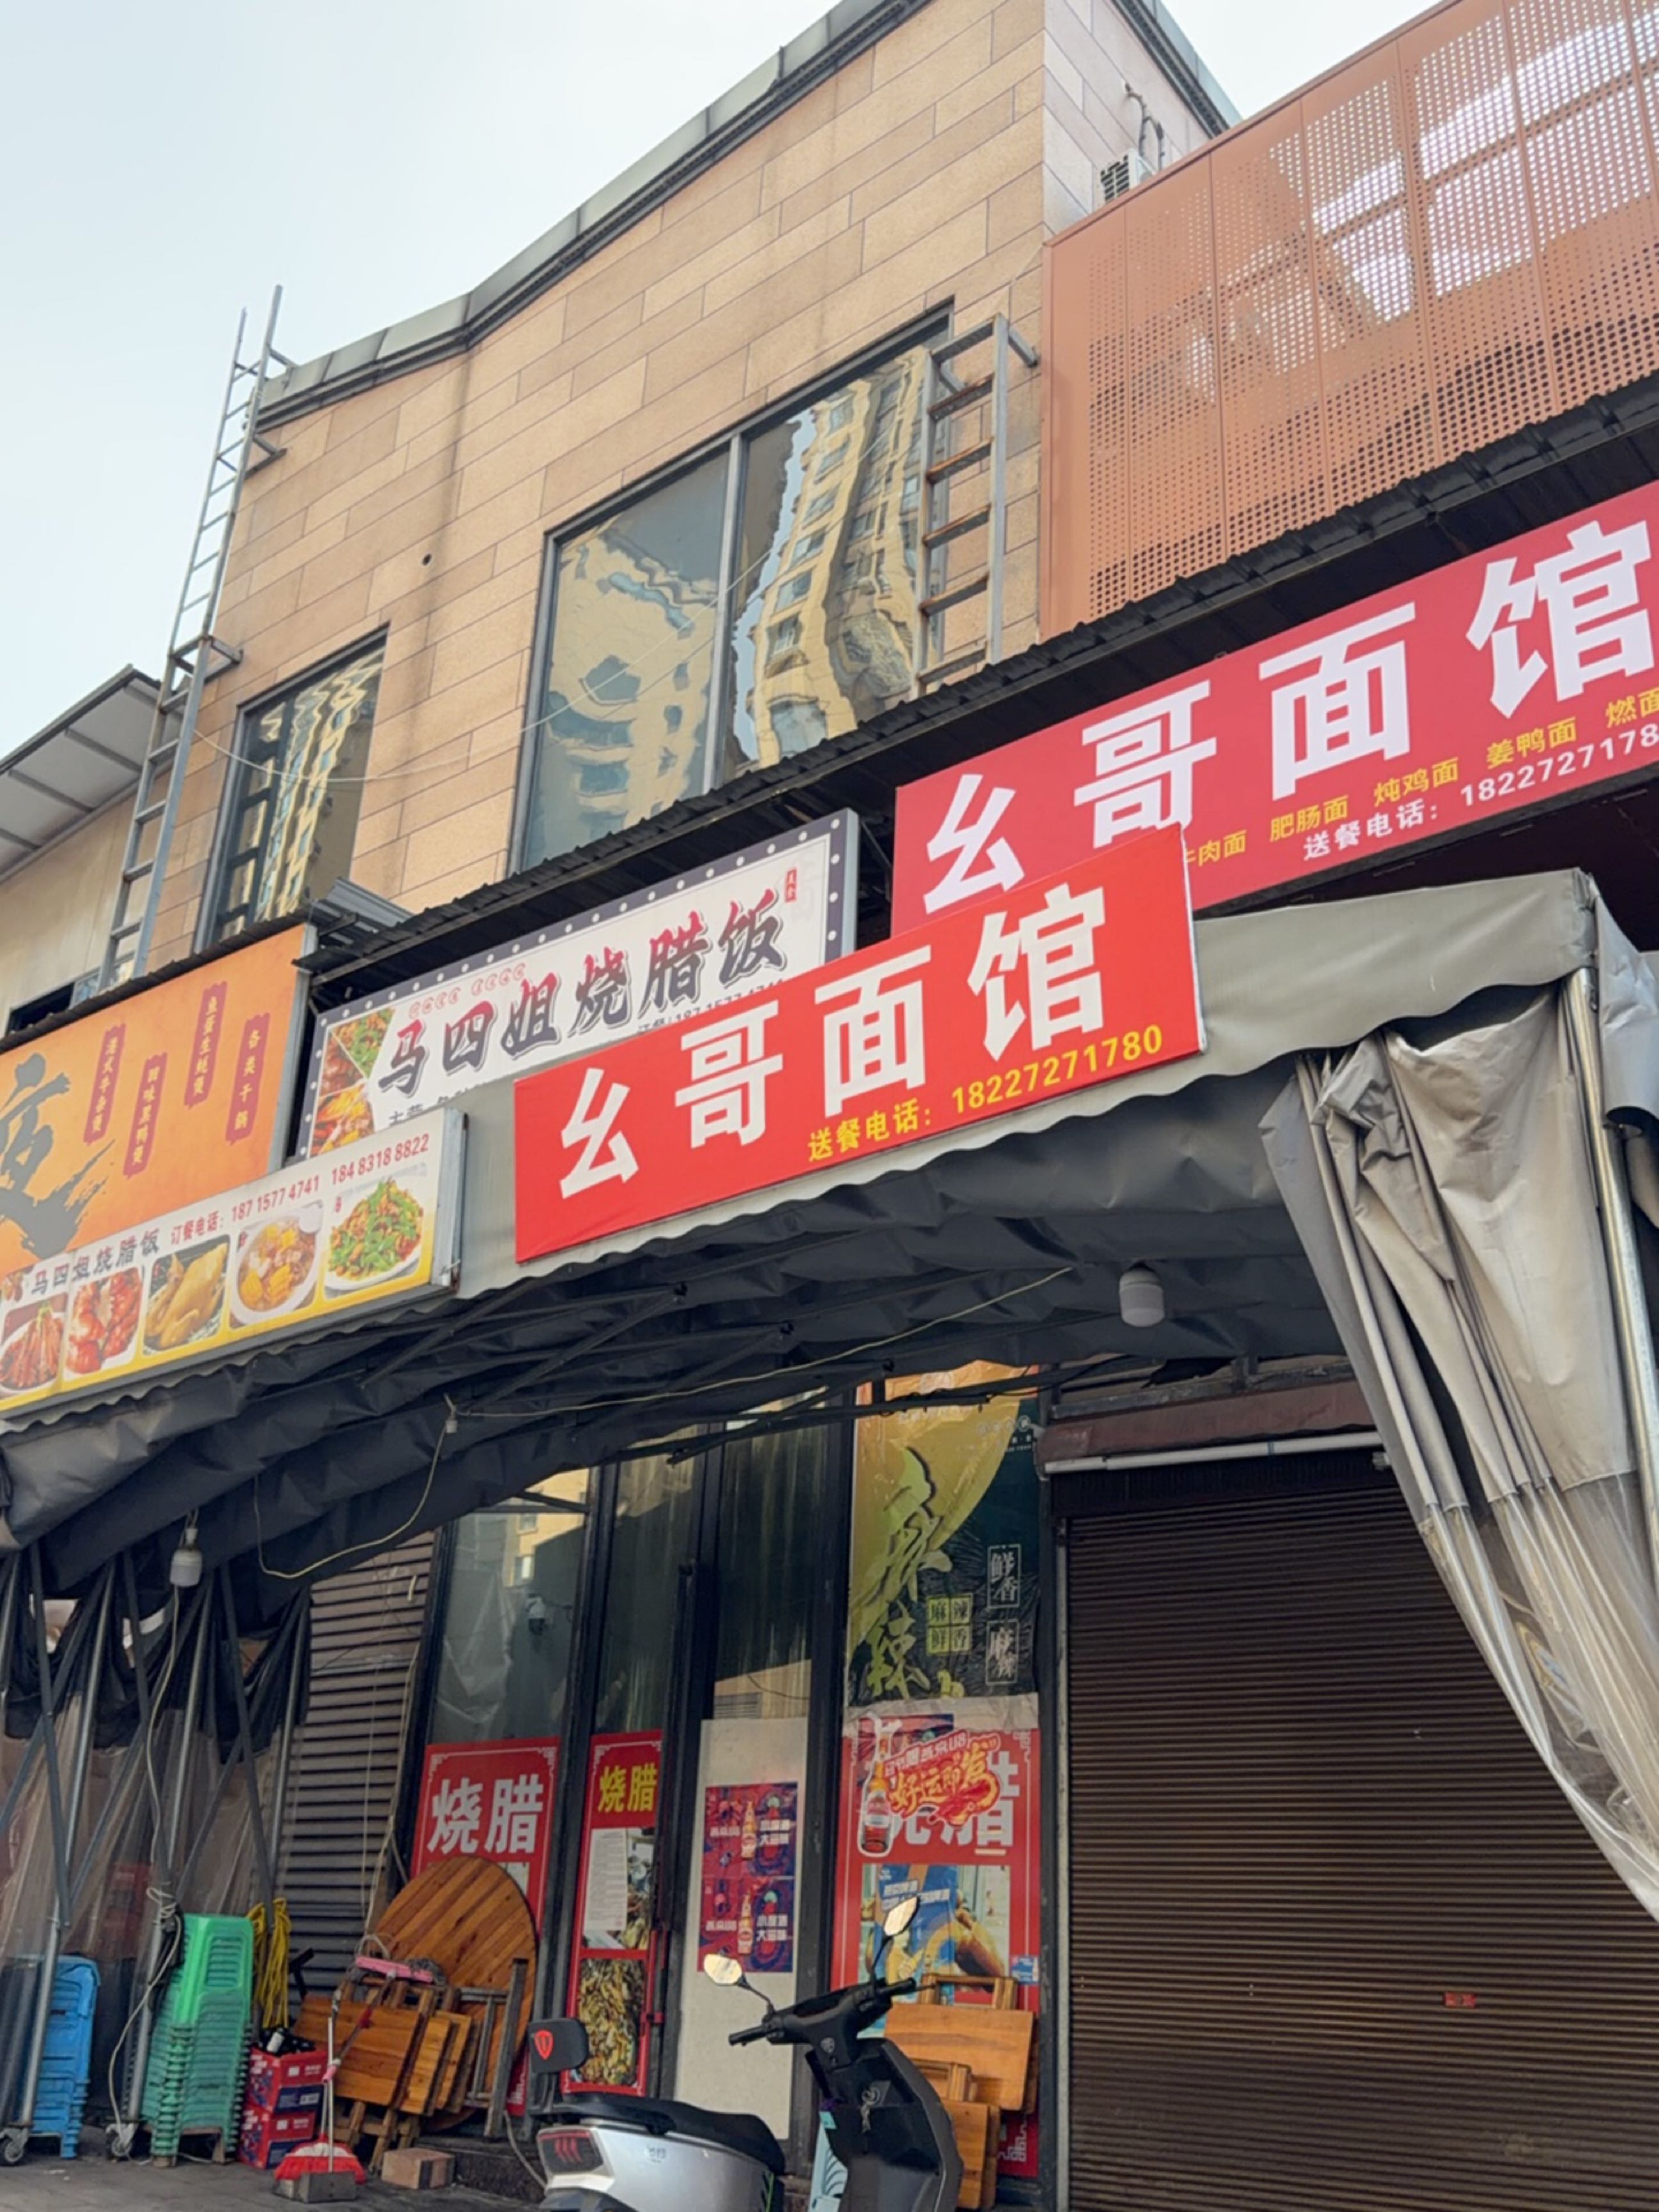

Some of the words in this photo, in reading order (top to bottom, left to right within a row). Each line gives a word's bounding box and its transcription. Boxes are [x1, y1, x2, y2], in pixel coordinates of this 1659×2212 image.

[1270, 794, 1349, 843] 肥肠面
[1374, 757, 1459, 807] 炖鸡面
[1486, 716, 1576, 769] 姜鸭面
[1605, 686, 1659, 728] 燃面
[378, 888, 787, 1098] 马四姐烧腊饭
[560, 883, 1106, 1199] 幺哥面馆
[952, 1025, 1162, 1113] 18227271780
[231, 1199, 253, 1221] 187
[257, 1187, 286, 1213] 1577
[332, 1161, 355, 1185] 184
[358, 1147, 392, 1176] 8318
[395, 1133, 429, 1162] 8822
[427, 1773, 544, 1854] 烧腊
[598, 1763, 658, 1813] 烧腊
